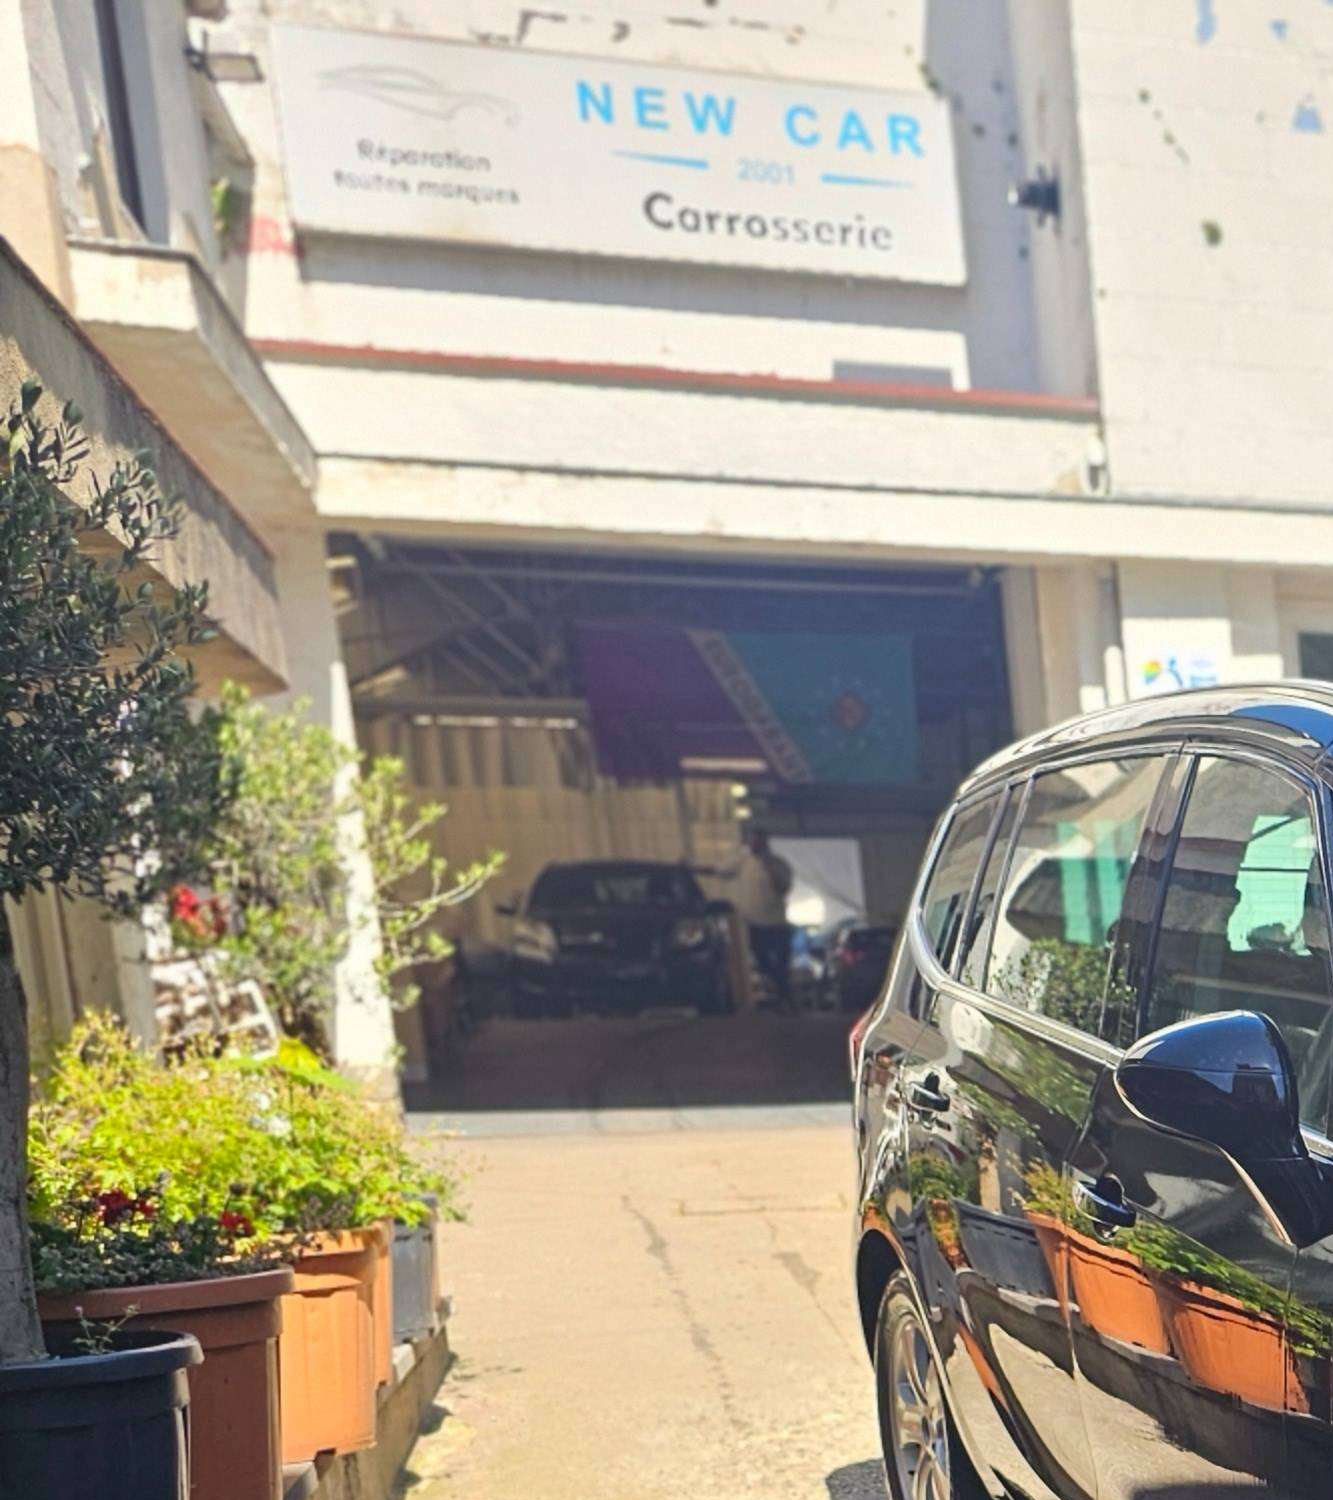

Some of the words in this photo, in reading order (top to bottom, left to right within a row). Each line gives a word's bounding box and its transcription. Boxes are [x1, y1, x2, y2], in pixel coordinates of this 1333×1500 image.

[577, 79, 737, 136] NEW
[785, 105, 926, 157] CAR
[418, 180, 520, 204] marques
[737, 159, 796, 186] 2001
[643, 192, 893, 252] Carrosserie
